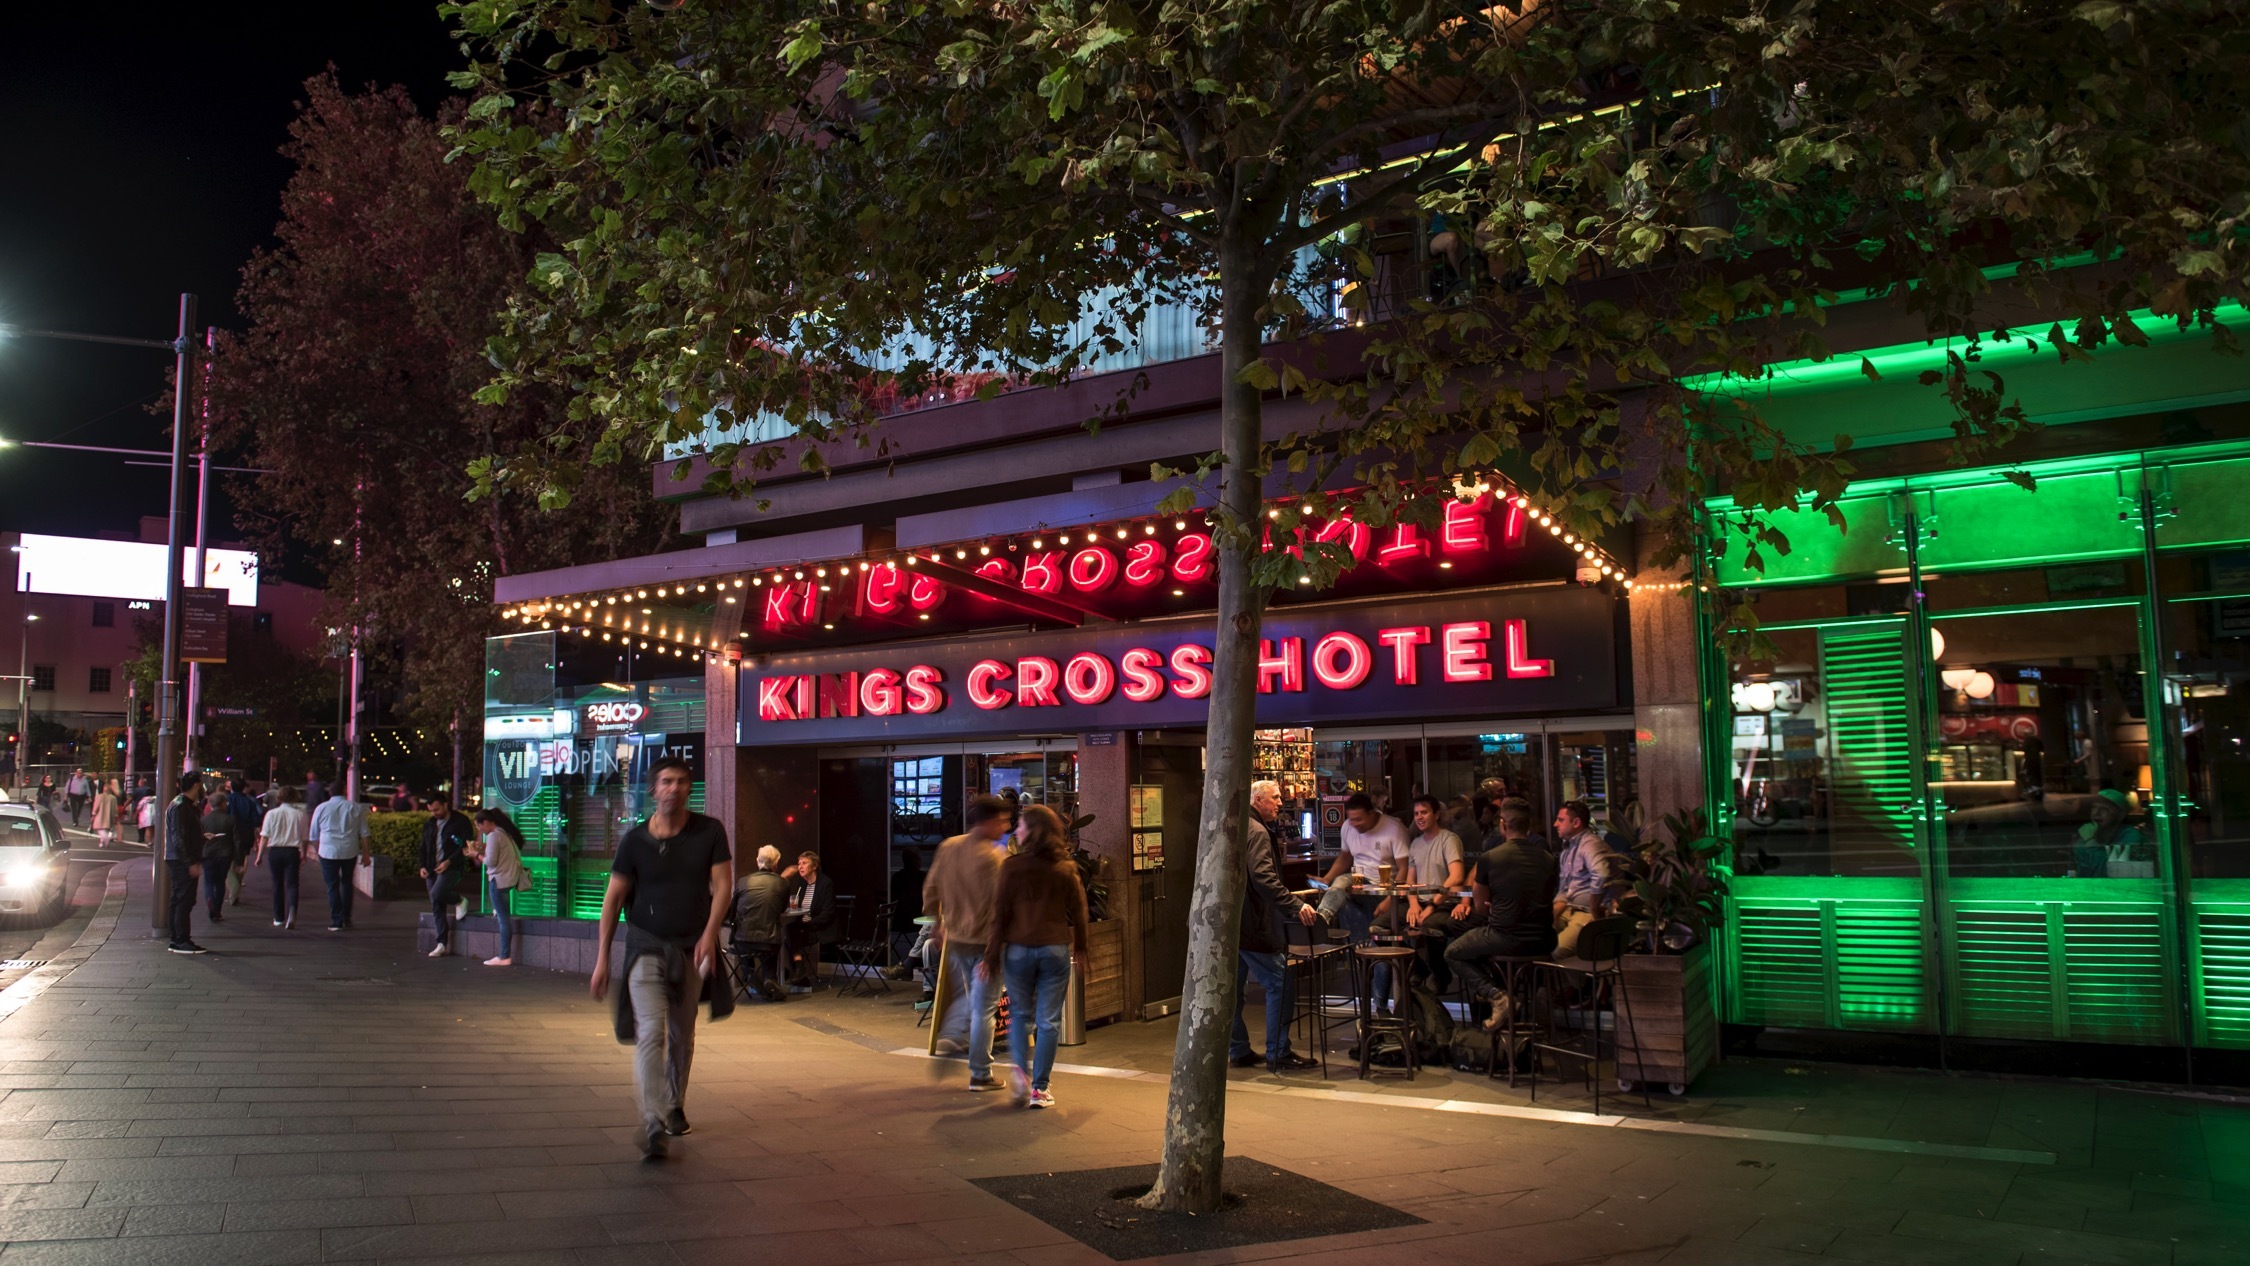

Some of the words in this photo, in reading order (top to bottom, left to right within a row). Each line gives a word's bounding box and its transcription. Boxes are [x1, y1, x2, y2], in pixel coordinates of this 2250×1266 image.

[128, 601, 150, 610] APN
[759, 664, 943, 721] KINGS
[967, 642, 1213, 710] CROSS
[1256, 619, 1555, 694] HOTEL
[217, 707, 245, 715] William
[246, 707, 253, 715] St
[498, 751, 539, 779] VIP
[504, 781, 531, 790] LOUNGE
[1329, 813, 1338, 822] 18
